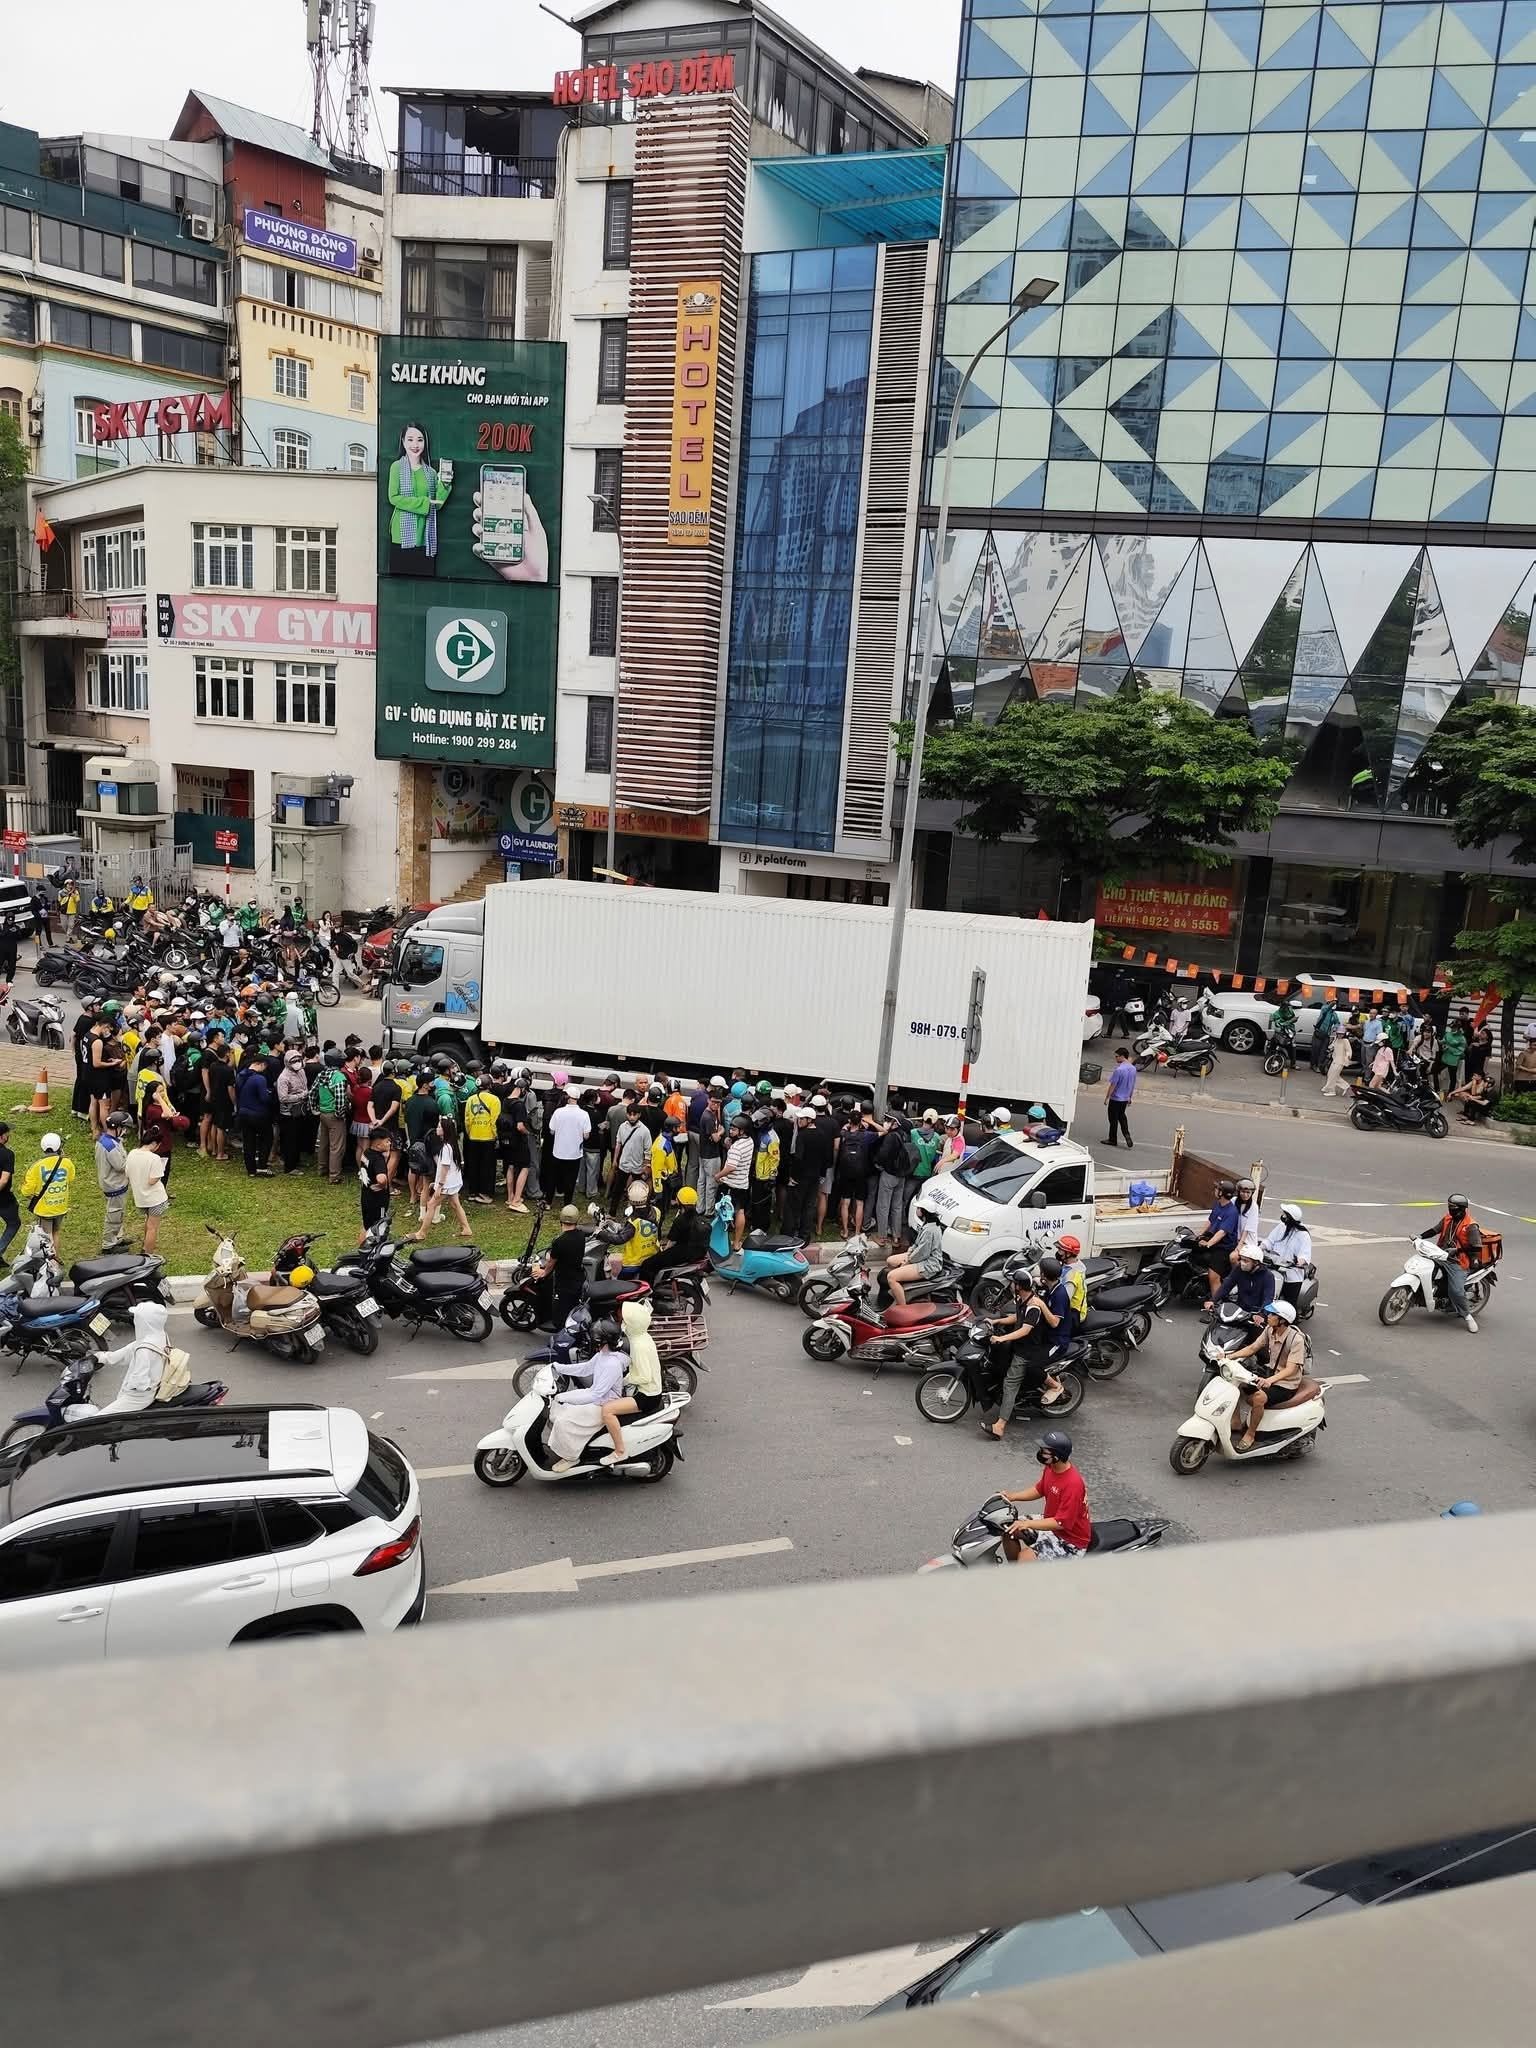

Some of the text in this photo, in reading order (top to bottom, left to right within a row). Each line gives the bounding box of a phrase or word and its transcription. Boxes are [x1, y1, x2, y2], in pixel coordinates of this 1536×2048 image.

[552, 49, 736, 107] HOTEL SAO ĐÊM
[254, 216, 348, 253] PHƯƠNG ĐÔNG
[268, 234, 336, 262] APARTMENT
[391, 360, 486, 386] SALE KHỦNG
[467, 392, 549, 406] CHO BẠN MỚI TẢI APP
[679, 324, 711, 499] HOTEL
[93, 390, 233, 441] SKY GYM
[477, 422, 534, 452] 200K
[669, 511, 687, 524] SAO
[182, 602, 264, 638] SKY
[278, 607, 372, 645] GYM
[385, 705, 401, 721] GV
[410, 702, 436, 724] ỨNG
[439, 709, 472, 728] DỤNG
[475, 709, 498, 731] ĐẶT
[501, 713, 517, 730] XE
[520, 713, 546, 734] VIỆT
[412, 731, 517, 750] Hotline: 1900 299 284
[513, 838, 558, 851] GV LAUNDRY
[764, 853, 807, 867] platform
[1102, 887, 1126, 900] CHO
[1142, 915, 1169, 927] 0922
[1174, 919, 1187, 928] 84
[1191, 920, 1220, 931] 5555
[910, 1021, 967, 1040] 98H-079.6
